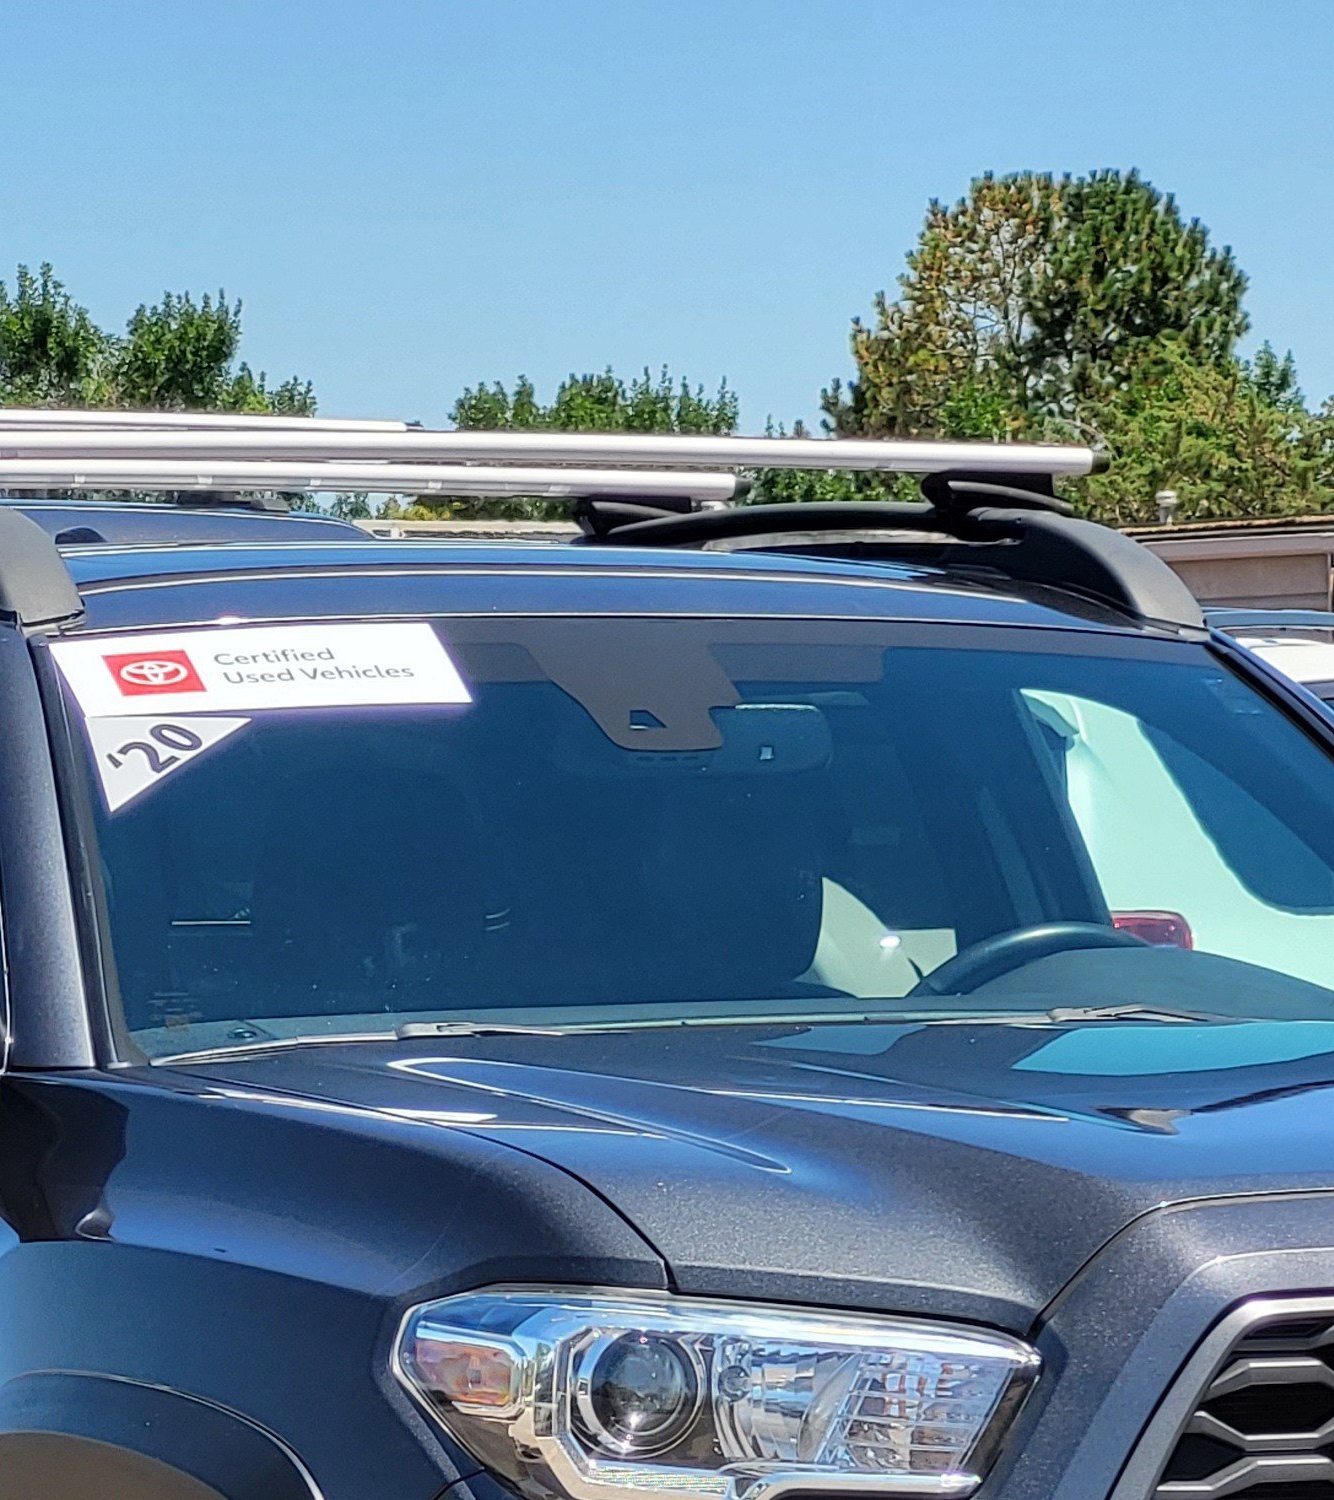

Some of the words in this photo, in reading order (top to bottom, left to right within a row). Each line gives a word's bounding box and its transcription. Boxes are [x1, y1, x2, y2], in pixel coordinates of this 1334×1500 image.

[213, 647, 336, 666] Certified
[223, 669, 296, 685] Used
[303, 664, 415, 682] Vehicles
